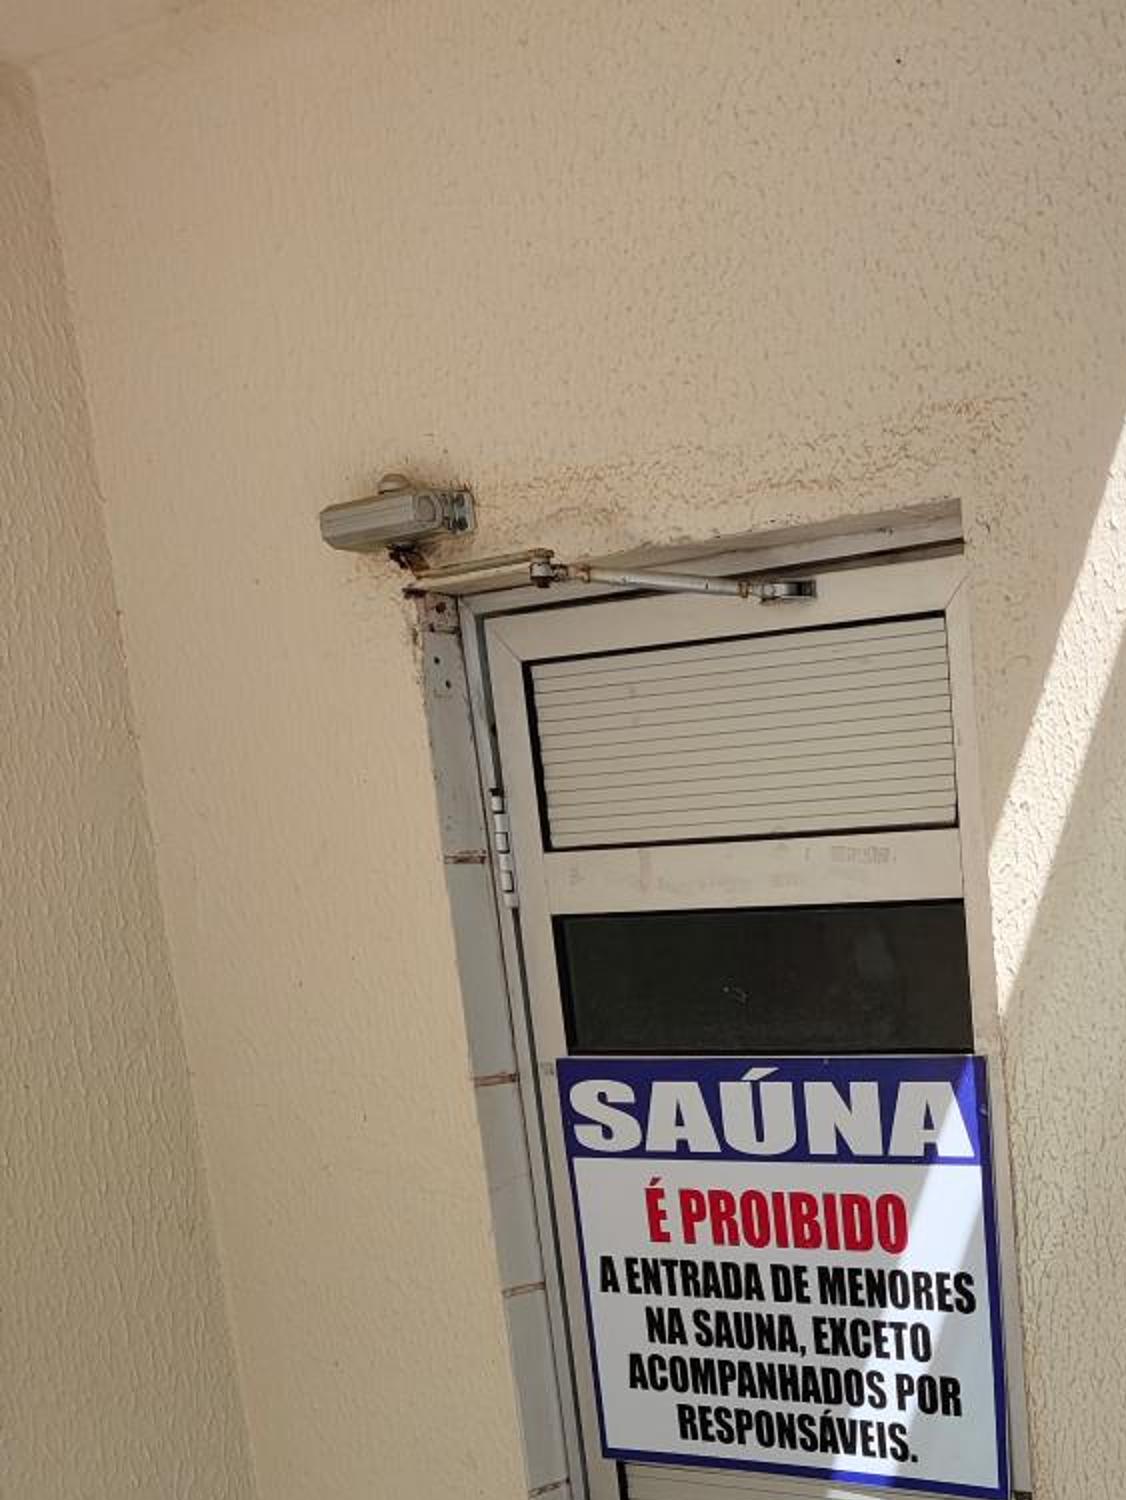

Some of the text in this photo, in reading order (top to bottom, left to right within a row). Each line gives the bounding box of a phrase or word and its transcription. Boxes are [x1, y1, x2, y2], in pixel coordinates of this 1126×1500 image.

[568, 1066, 975, 1157] SAÚNA
[644, 1177, 909, 1254] É PROIBIDO
[600, 1255, 977, 1314] A ENTRADA DE MENORES
[645, 1306, 932, 1363] NA SAUNA, EXCETO
[628, 1353, 963, 1416] ACOMPANHADOS POR
[677, 1403, 919, 1463] RESPONSÁVEIS.
